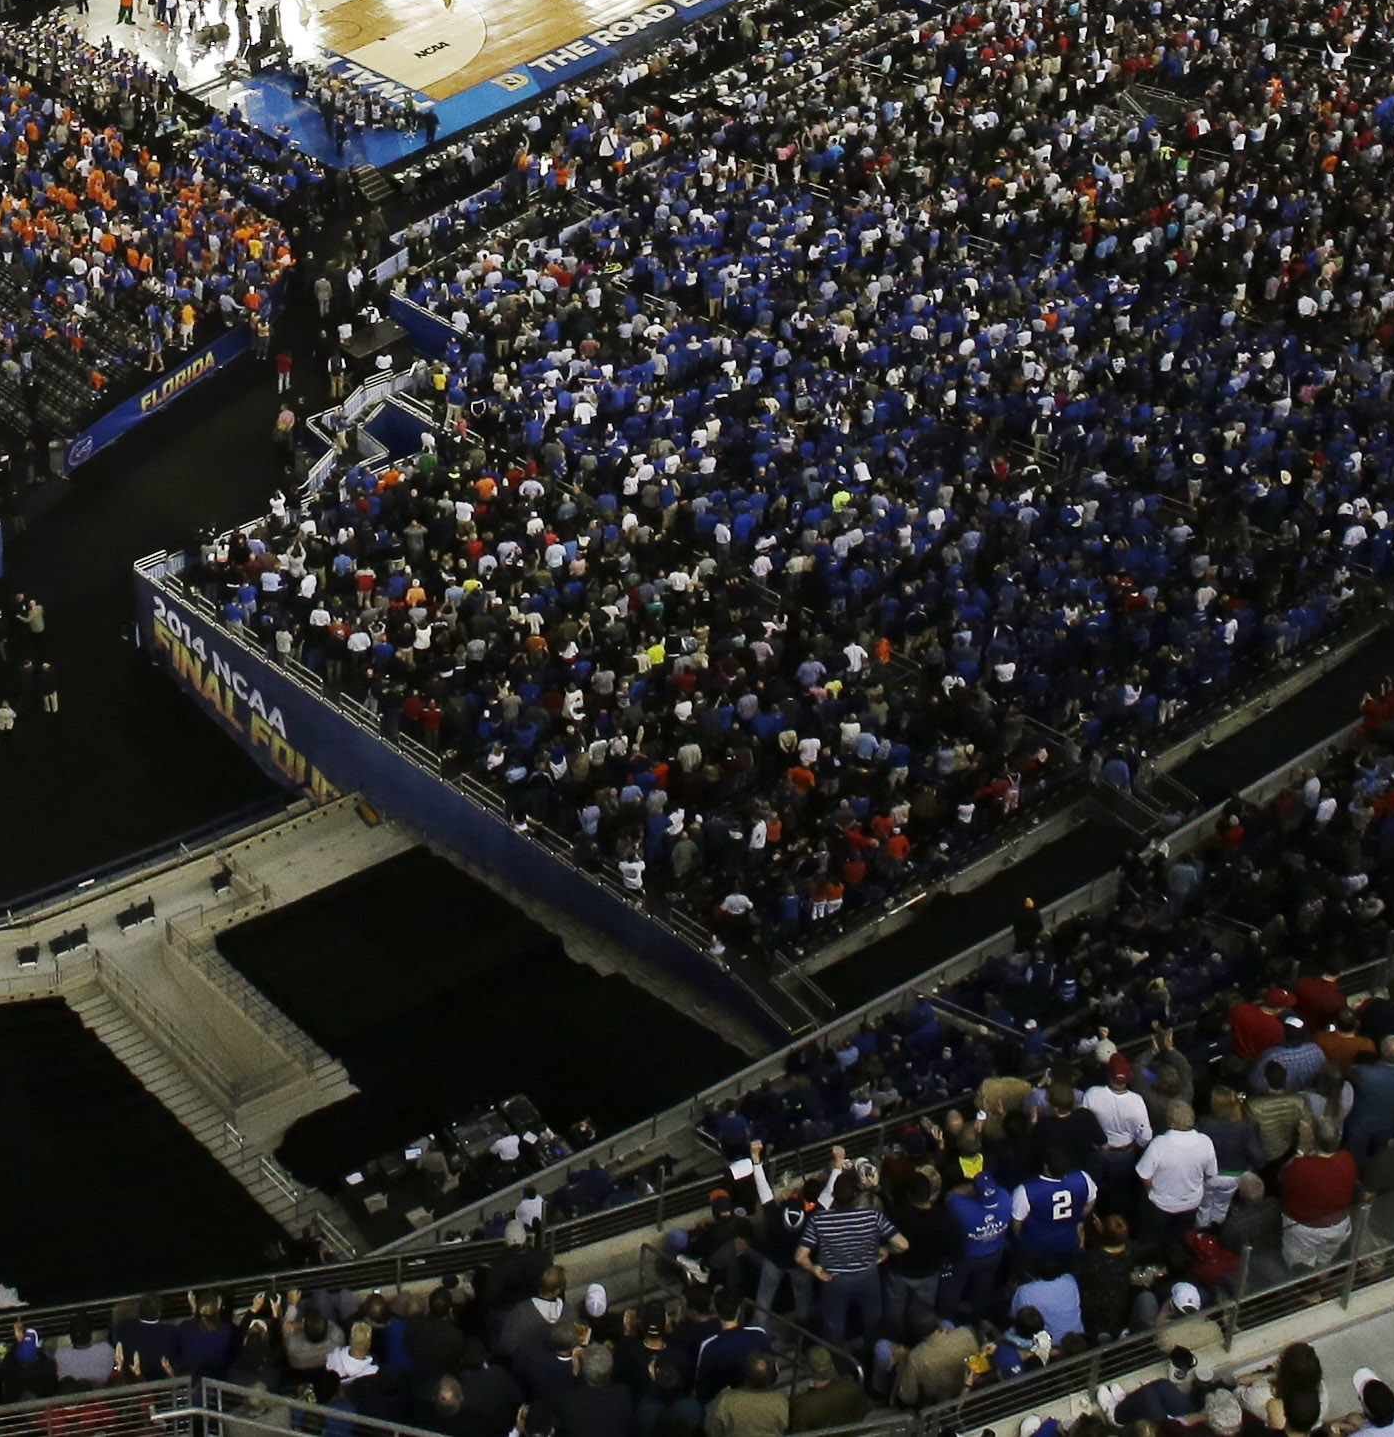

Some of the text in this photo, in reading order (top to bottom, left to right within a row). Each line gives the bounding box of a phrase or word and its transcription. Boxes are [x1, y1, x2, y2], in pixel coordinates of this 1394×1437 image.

[414, 41, 451, 59] NCAA
[528, 38, 597, 73] THE
[594, 5, 676, 47] ROAD
[140, 352, 215, 412] FLORIDA
[153, 596, 287, 739] 2014 NCAA
[153, 618, 341, 805] FINAL FOUR
[1052, 1190, 1073, 1220] 2
